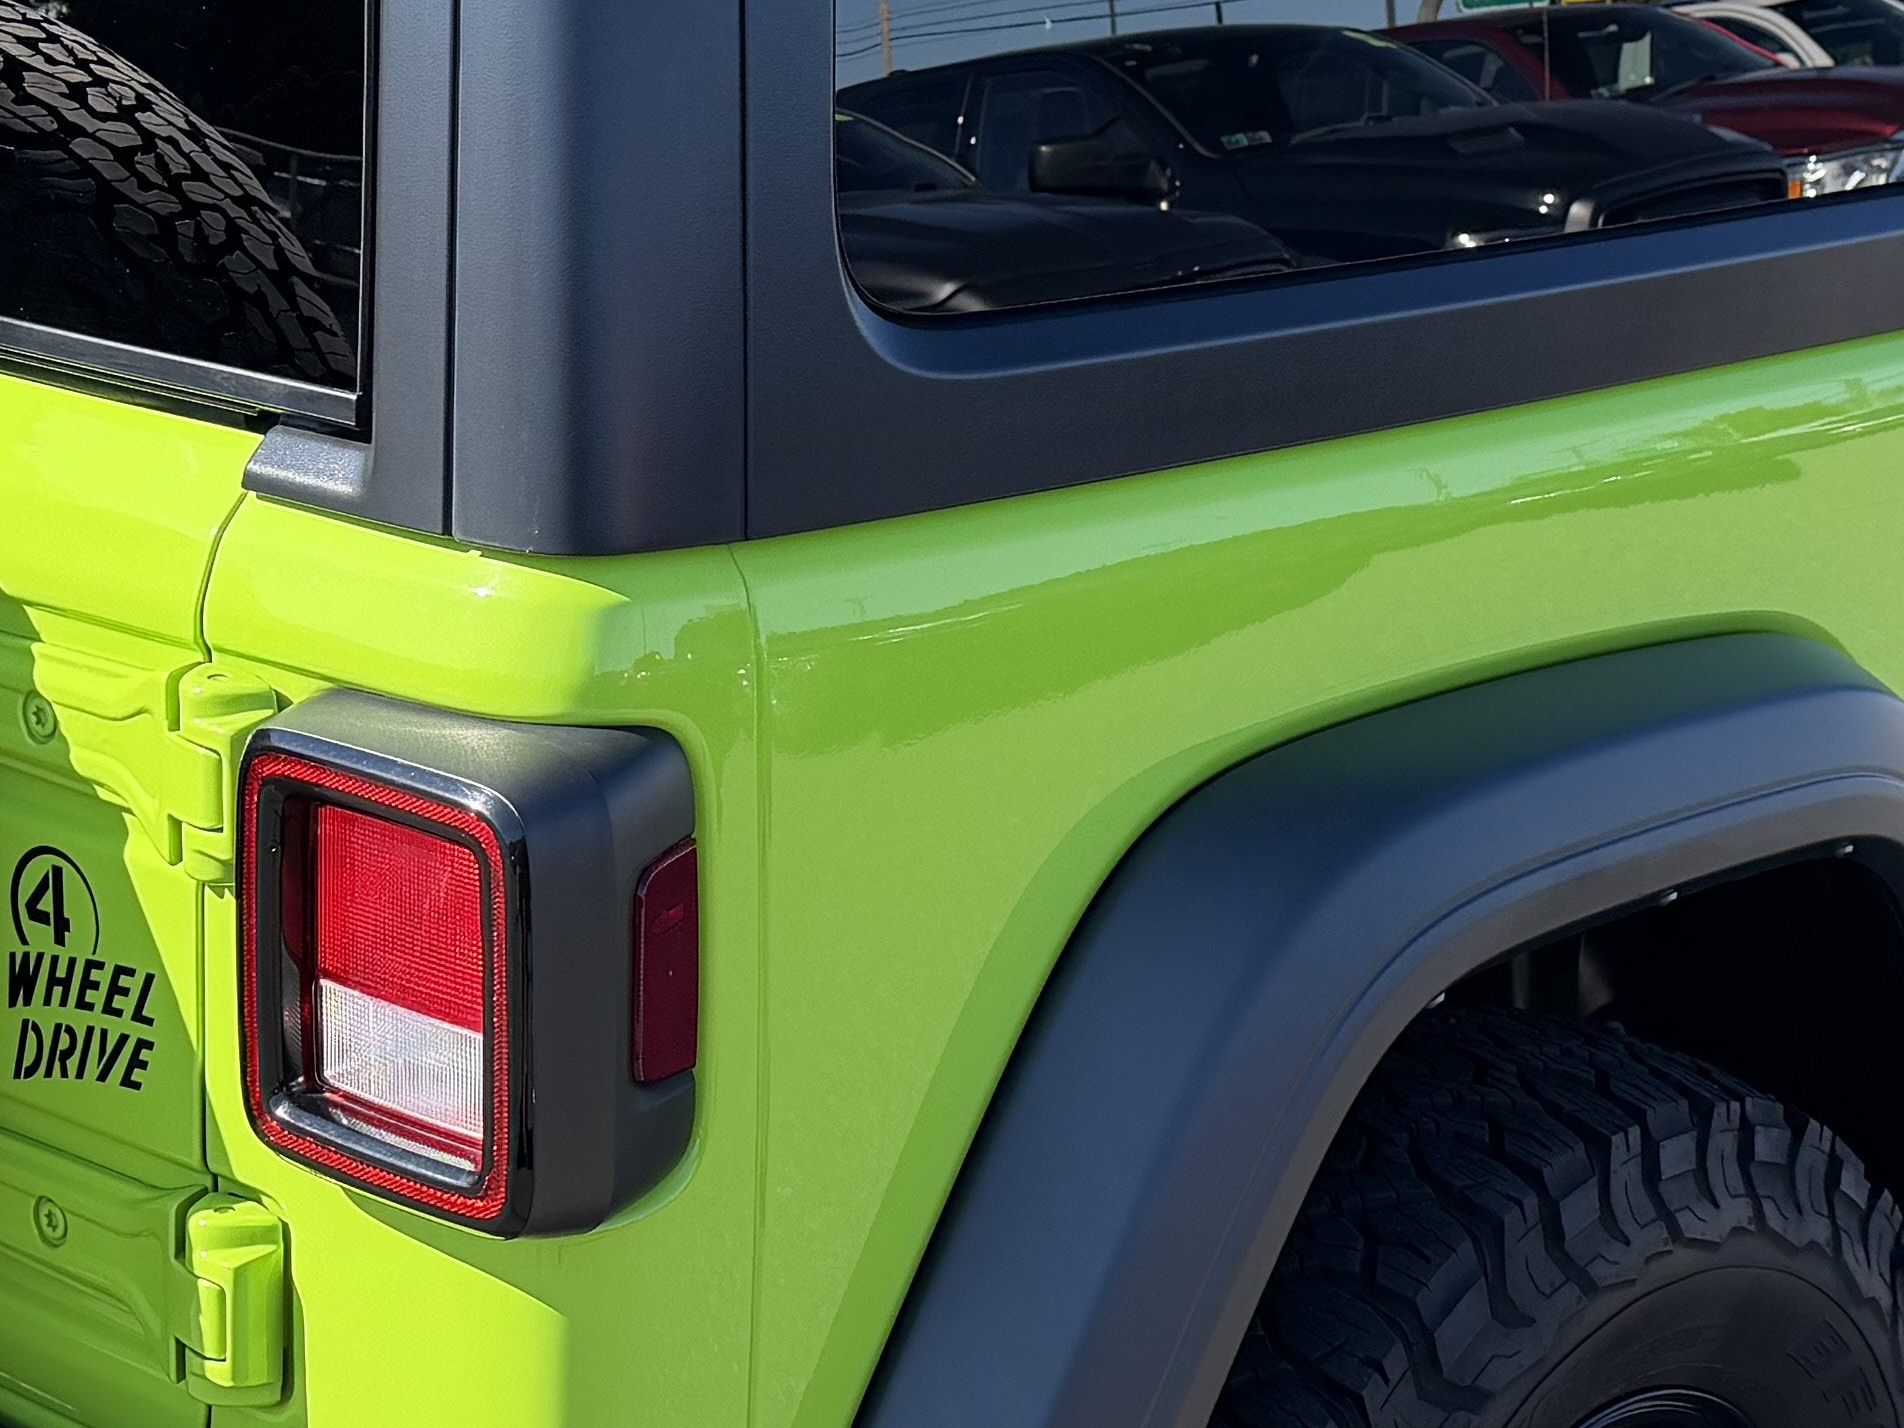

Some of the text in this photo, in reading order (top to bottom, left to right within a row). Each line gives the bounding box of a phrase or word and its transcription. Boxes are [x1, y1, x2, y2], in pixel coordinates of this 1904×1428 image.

[24, 863, 71, 948] 4
[8, 950, 156, 1028] WHEEL
[12, 1018, 156, 1091] DRIVE
